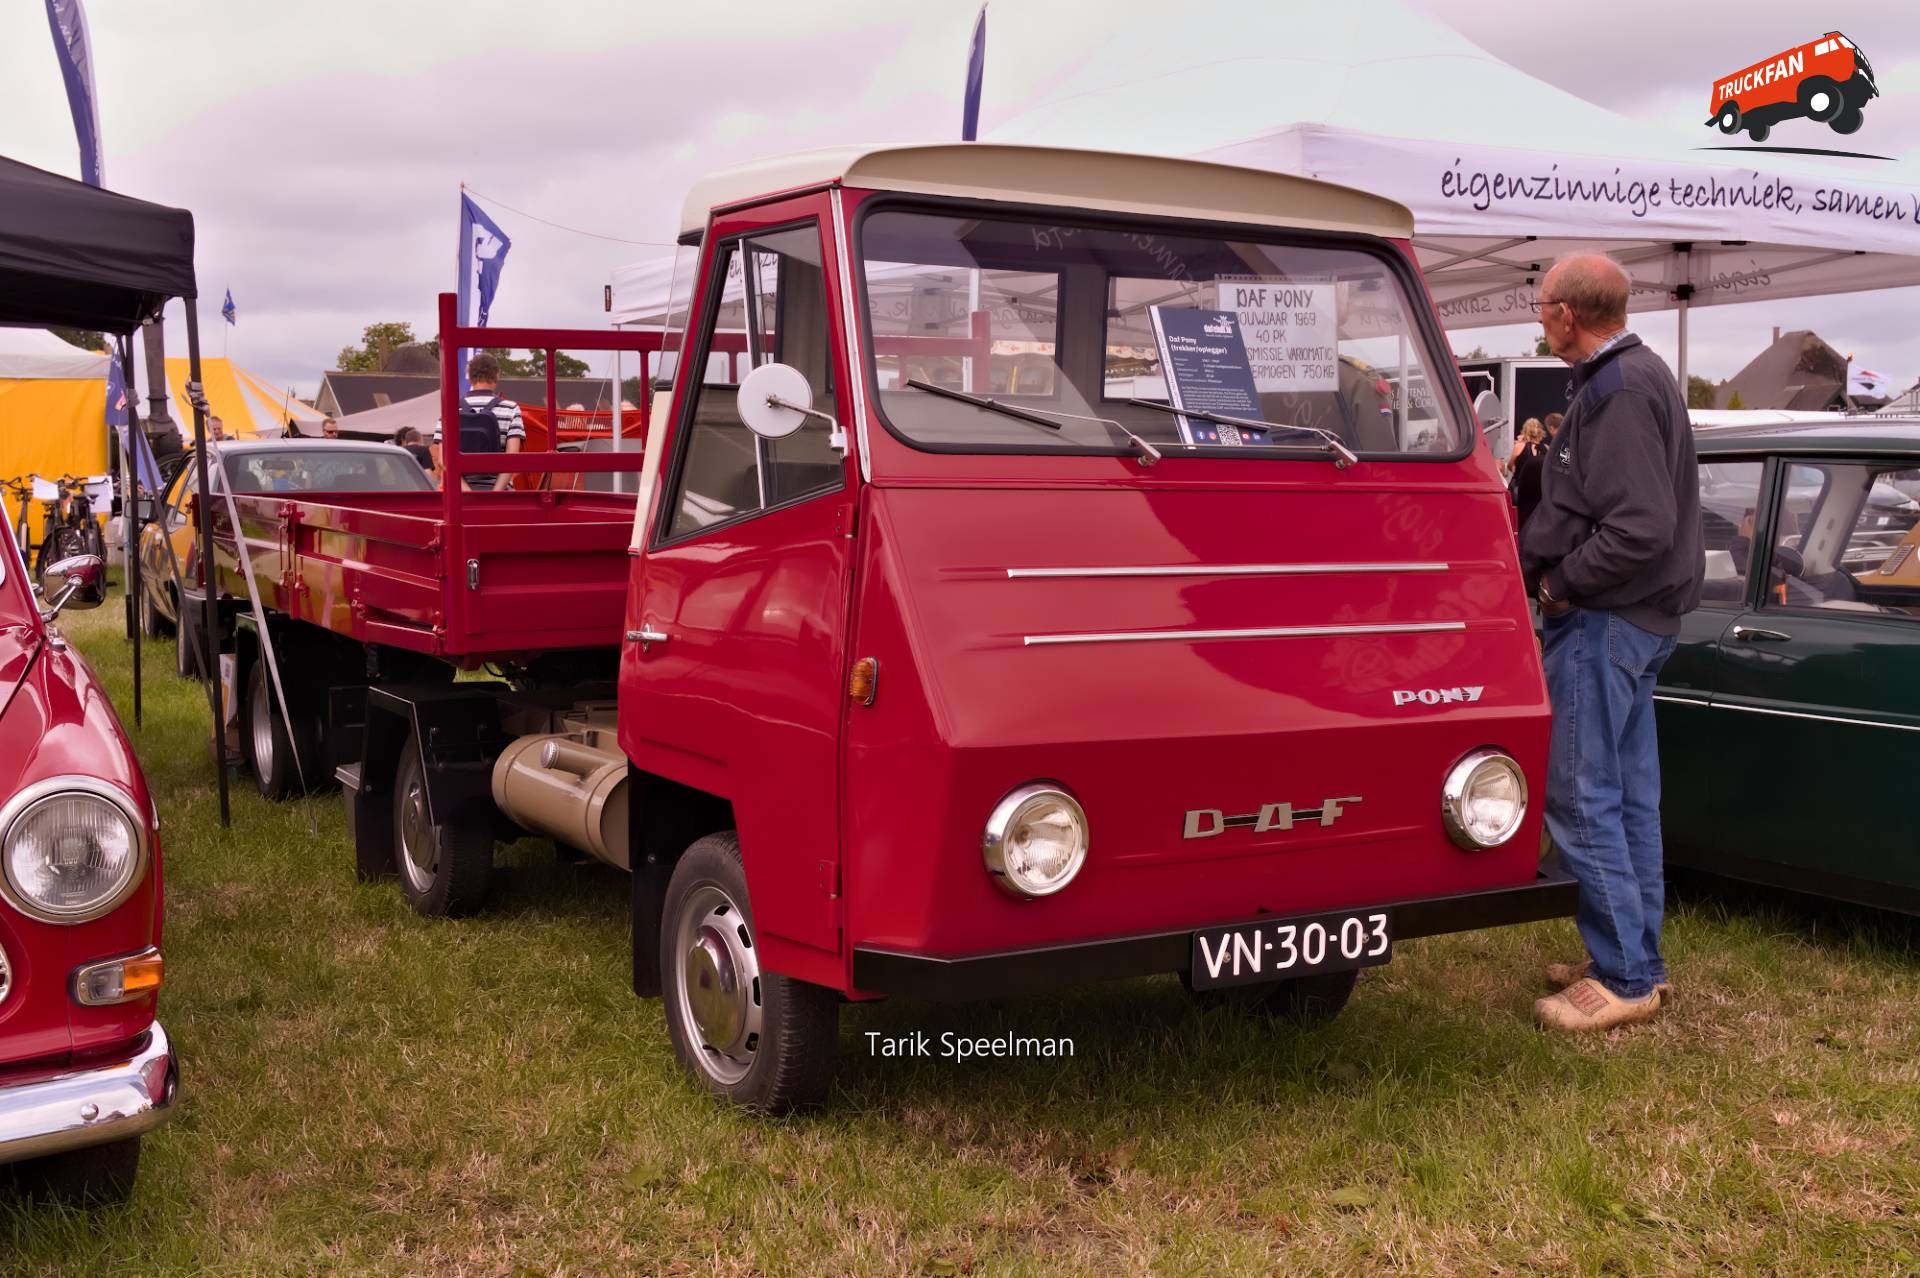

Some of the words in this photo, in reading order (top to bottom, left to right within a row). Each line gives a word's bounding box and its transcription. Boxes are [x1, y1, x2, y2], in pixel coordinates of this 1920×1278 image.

[1441, 157, 1662, 218] eigenzinnige
[1669, 172, 1802, 215] techniek,
[1812, 188, 1907, 220] samen
[1236, 288, 1267, 308] DAF
[1274, 289, 1313, 309] PONY
[1239, 312, 1289, 327] OUWJAAR
[1294, 312, 1317, 327] 1969
[1256, 329, 1270, 343] 40
[1273, 330, 1287, 343] PK
[1246, 346, 1284, 361] SMISSIE
[1250, 364, 1296, 379] ERMOGEN
[1393, 686, 1485, 706] PONY
[1183, 796, 1363, 839] DAF
[1199, 913, 1388, 979] VN-30-03
